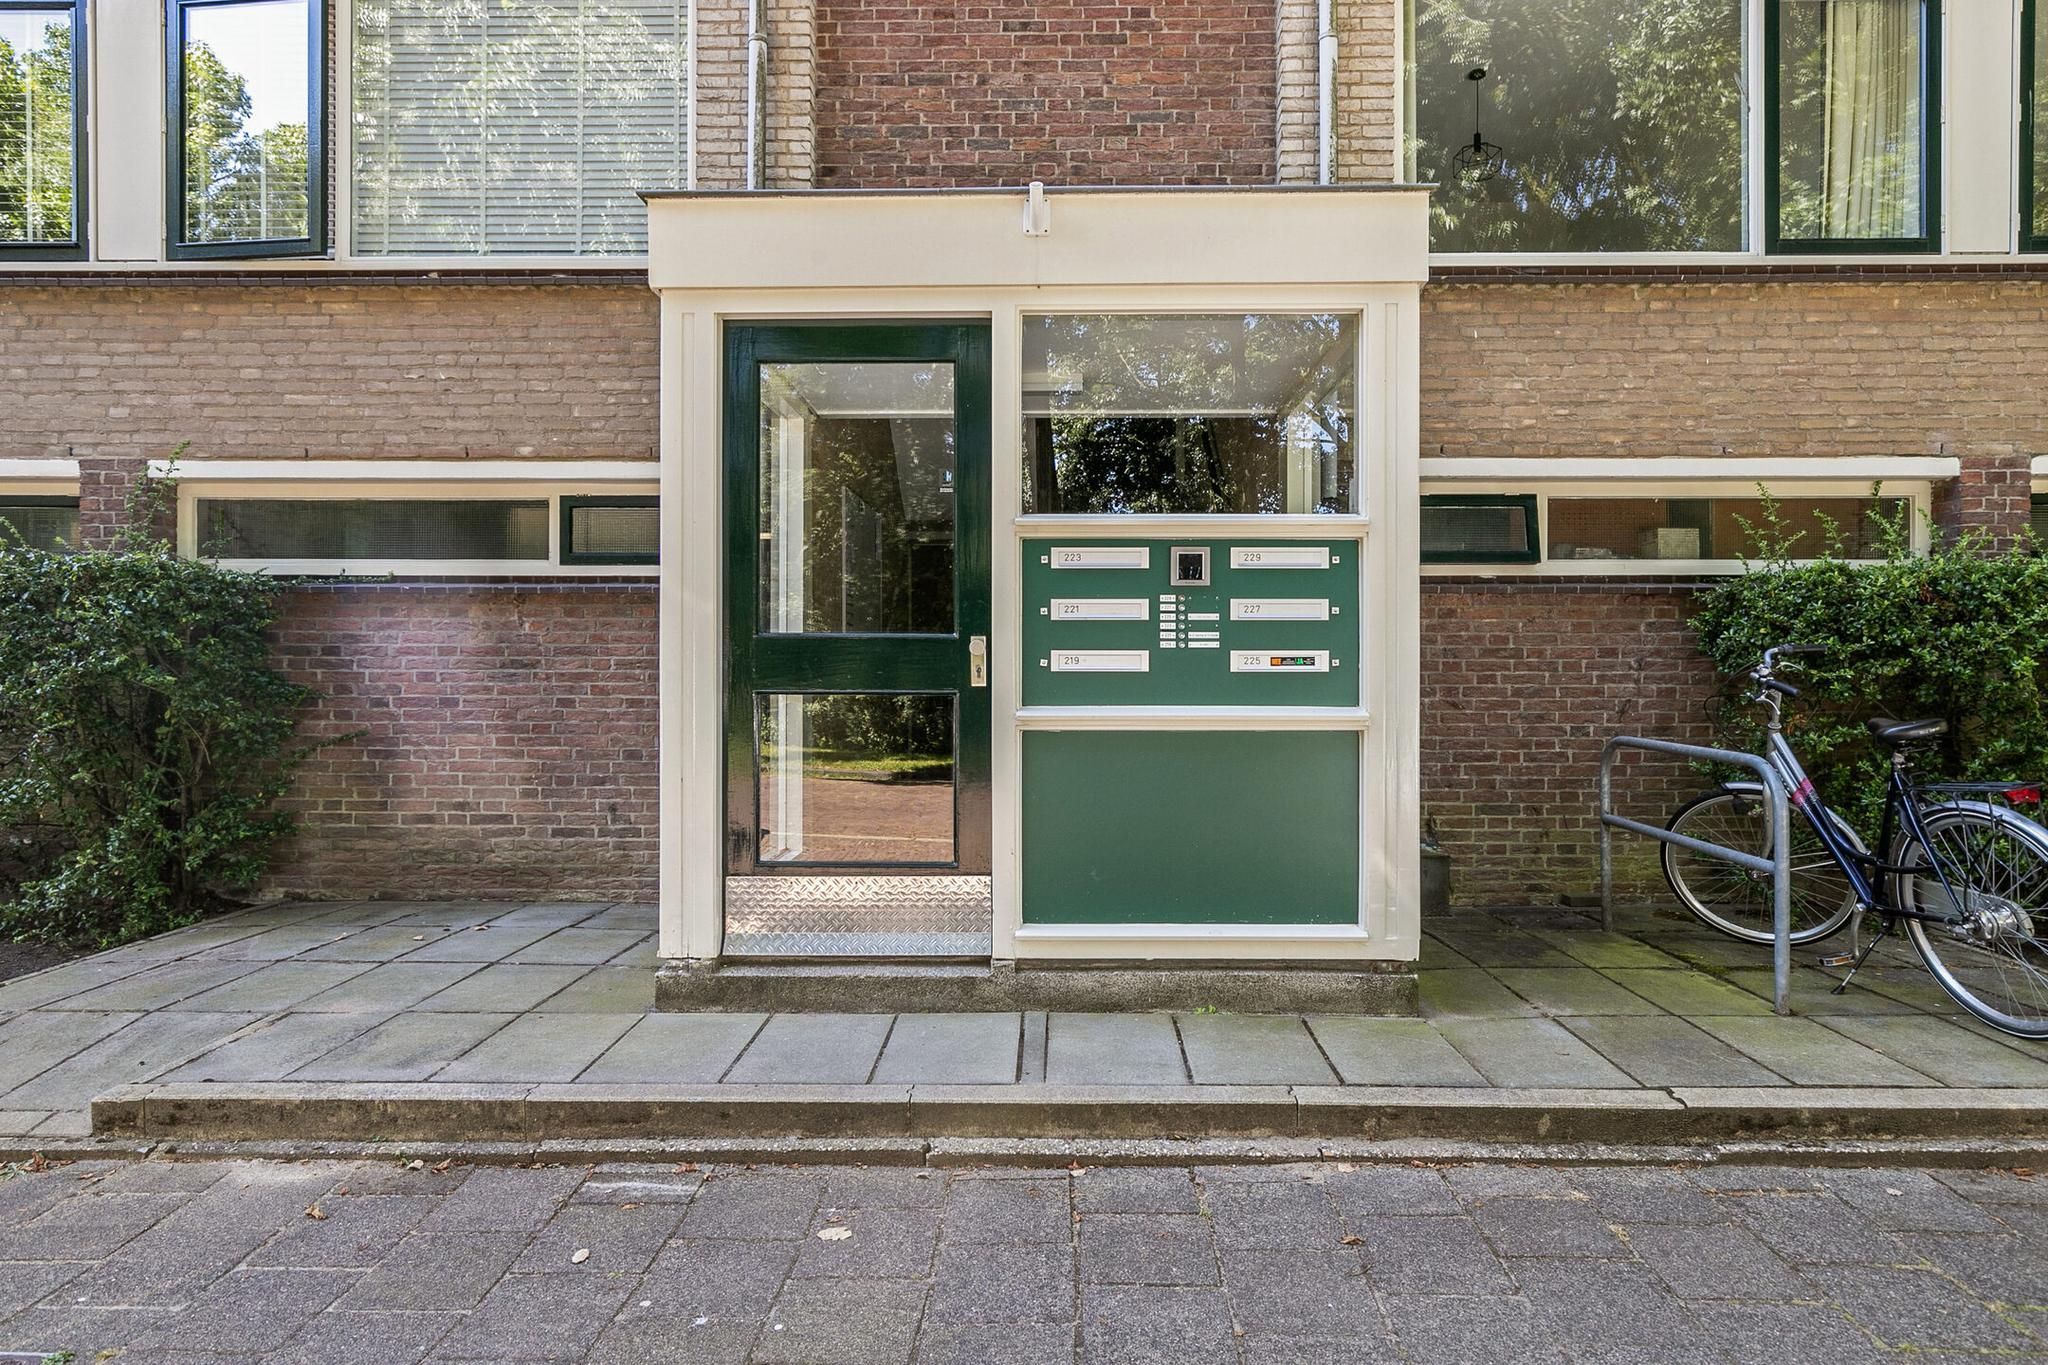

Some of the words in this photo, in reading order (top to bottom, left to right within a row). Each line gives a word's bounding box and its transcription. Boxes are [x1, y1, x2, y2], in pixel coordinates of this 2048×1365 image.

[1064, 553, 1082, 562] 223
[1243, 553, 1262, 562] 229
[1064, 605, 1080, 614] 221
[1243, 605, 1261, 614] 227
[1064, 656, 1080, 665] 219
[1243, 656, 1261, 665] 225
